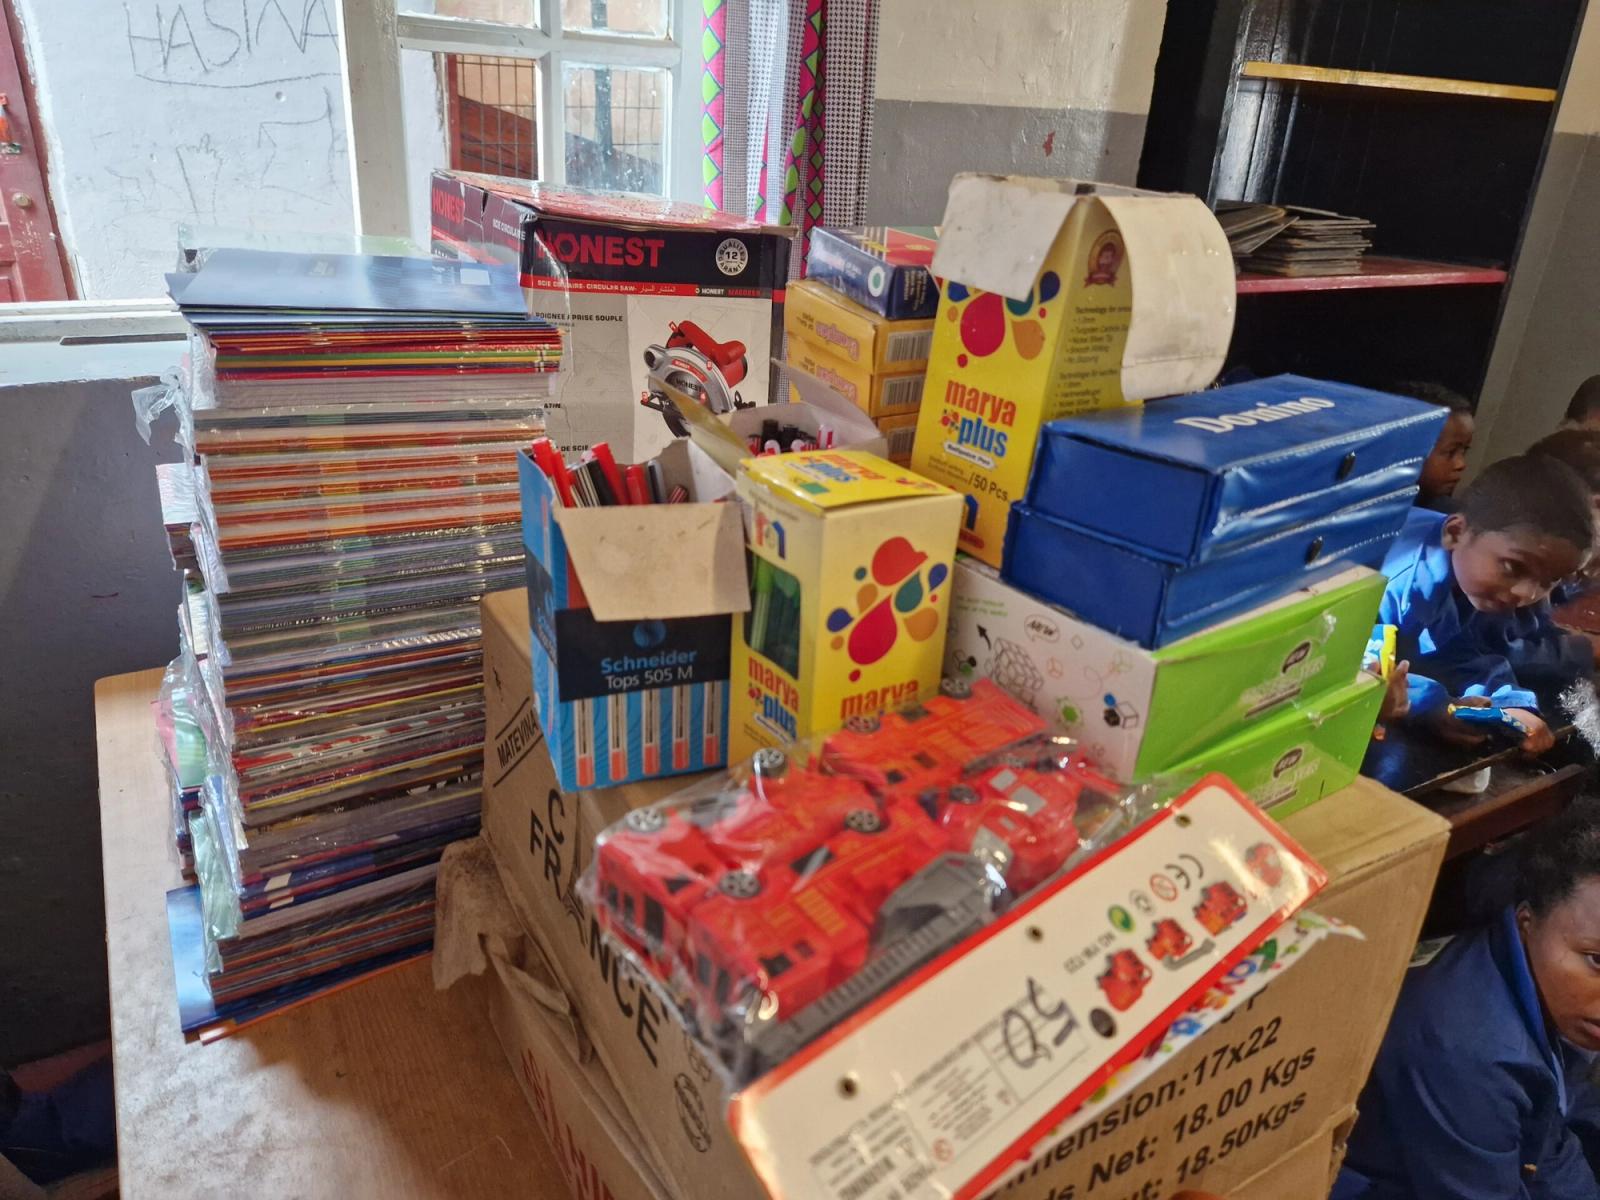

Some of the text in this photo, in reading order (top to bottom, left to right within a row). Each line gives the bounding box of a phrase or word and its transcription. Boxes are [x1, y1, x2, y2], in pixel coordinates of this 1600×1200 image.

[123, 0, 340, 75] HASINA
[536, 229, 664, 268] HONEST
[725, 251, 738, 260] 12
[537, 280, 551, 288] SCIE
[586, 283, 619, 291] CIRCULAR
[702, 287, 725, 295] HONEST
[535, 312, 565, 320] POIGNEE
[944, 379, 1017, 428] marya
[1173, 395, 1336, 435] Domino
[957, 416, 1008, 458] plus
[988, 481, 1008, 502] Pcs
[601, 649, 698, 674] Schneider
[606, 665, 693, 691] Tops 505 M
[764, 693, 797, 743] plus
[530, 808, 661, 1069] FRNCE
[1087, 1135, 1158, 1192] Net:
[1173, 1077, 1253, 1144] 18.00
[1259, 1046, 1317, 1095] Kgs
[1176, 1091, 1308, 1184] 18.50Kgs
